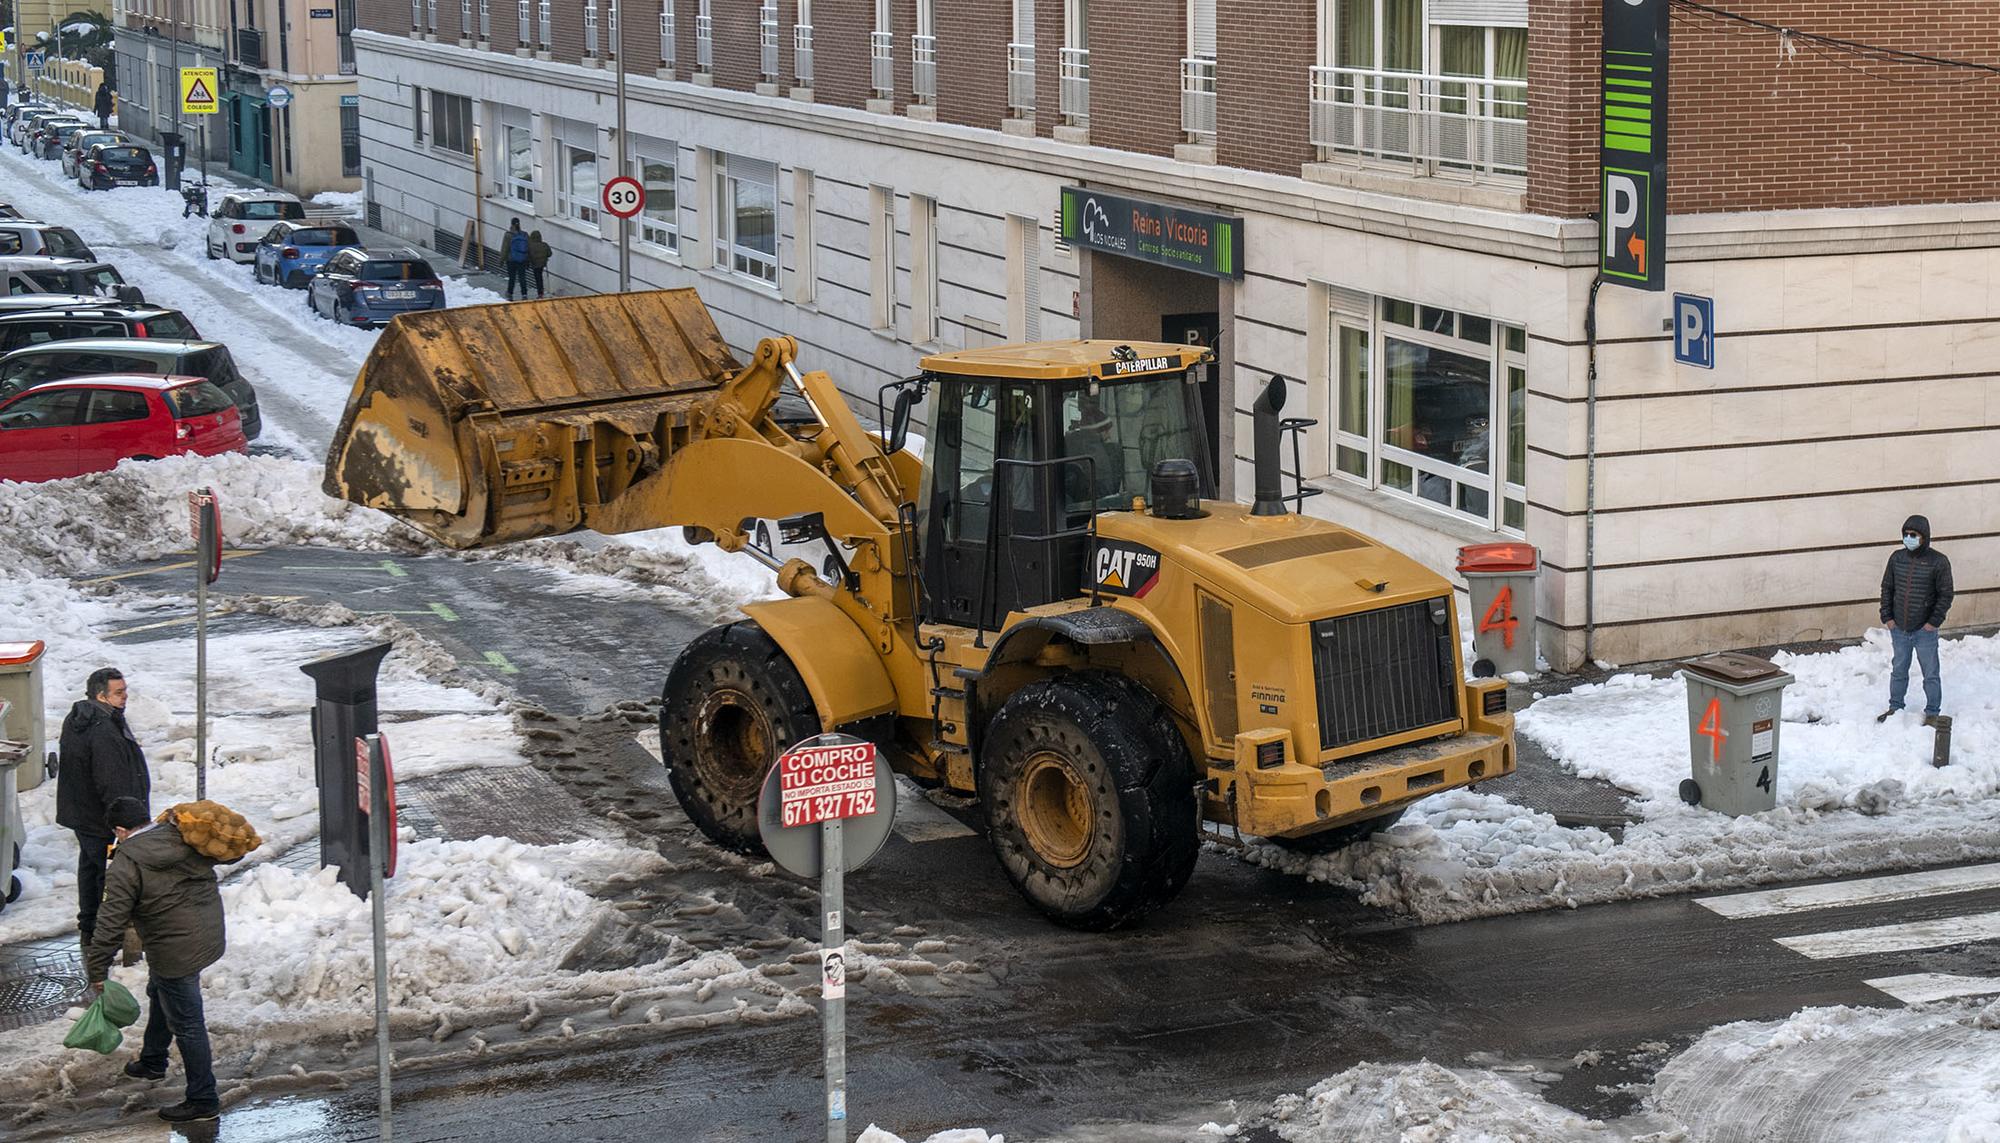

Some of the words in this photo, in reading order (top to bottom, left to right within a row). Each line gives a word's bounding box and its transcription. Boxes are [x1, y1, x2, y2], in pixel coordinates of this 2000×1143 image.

[611, 190, 636, 204] 30
[1132, 209, 1161, 237] Reina
[1165, 216, 1208, 247] Victoria
[1606, 174, 1638, 258] P
[1094, 232, 1104, 245] LOS
[1187, 330, 1199, 345] P
[1680, 303, 1703, 356] P
[1115, 357, 1168, 375] CATERPILLAR
[1096, 547, 1136, 589] CAT
[1136, 553, 1157, 569] 950H
[1478, 583, 1519, 649] 4
[1697, 697, 1727, 763] 4
[787, 747, 868, 771] COMPRO
[782, 771, 806, 788] TU
[810, 761, 874, 784] COCHE
[1756, 765, 1772, 794] 4
[784, 791, 796, 800] NO
[797, 786, 831, 797] IMPORTA
[831, 781, 862, 792] ESTADO
[784, 799, 811, 826] 671
[815, 795, 843, 820] 327
[846, 790, 875, 816] 752
